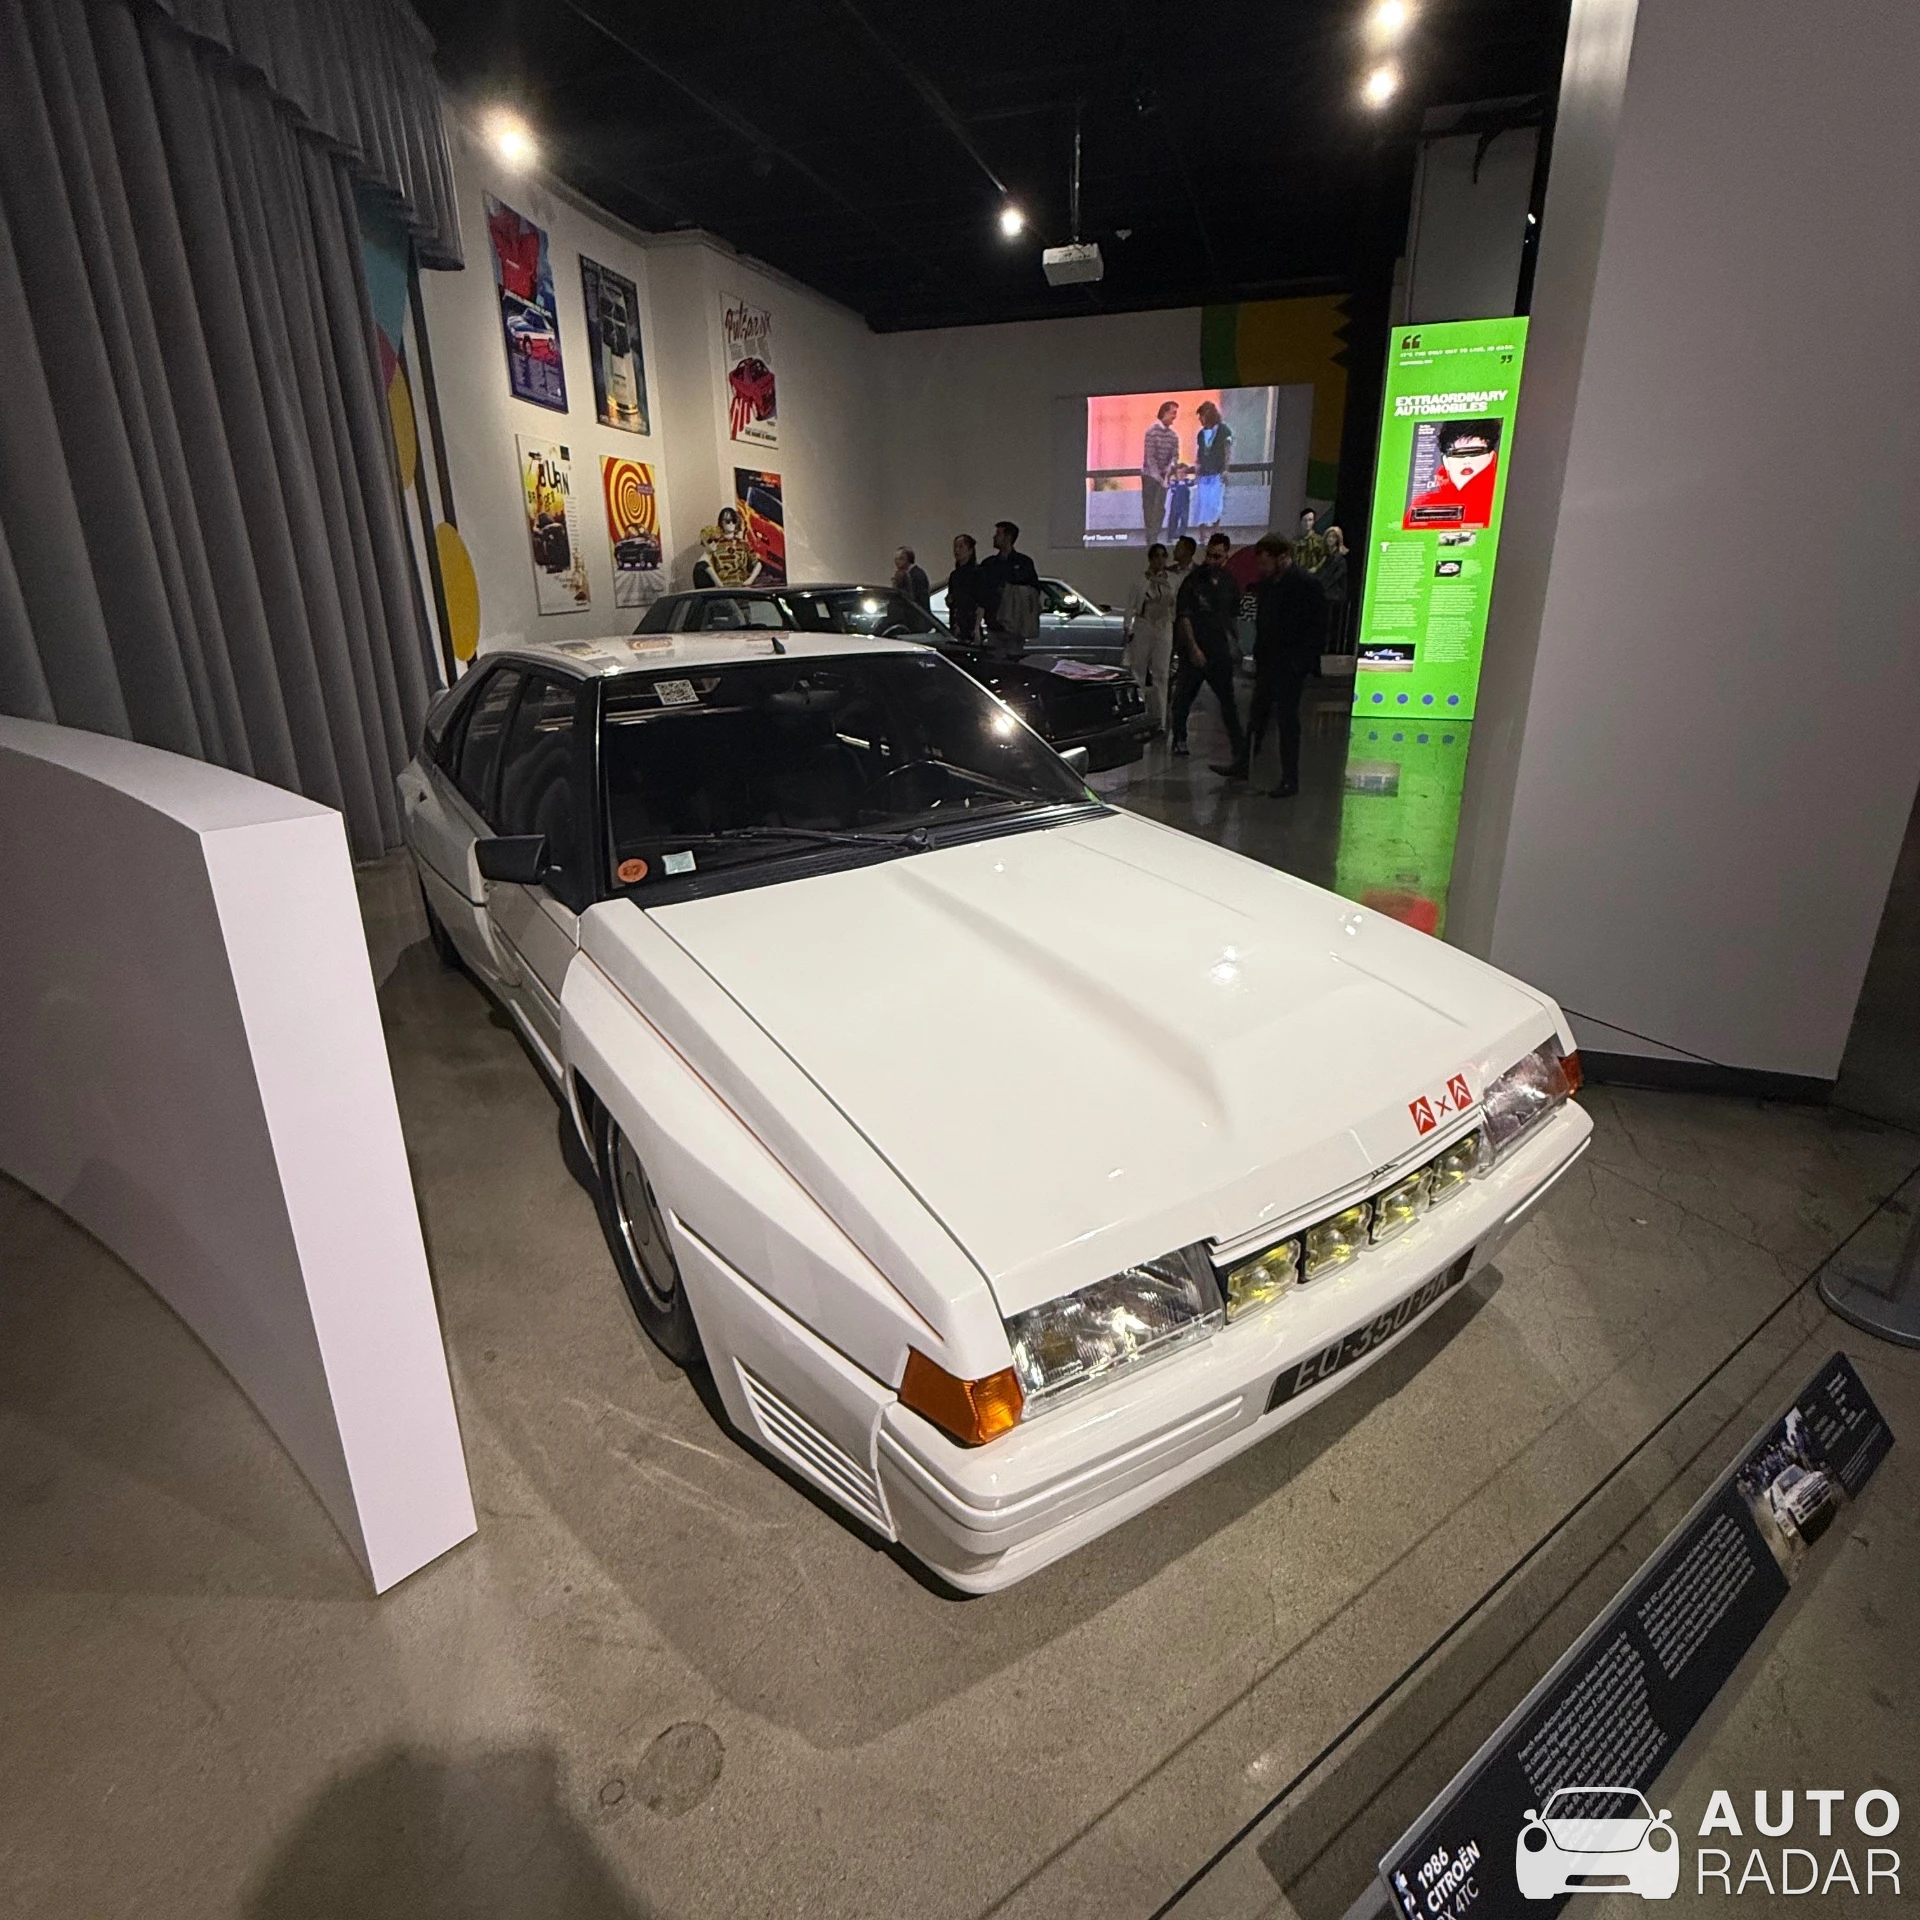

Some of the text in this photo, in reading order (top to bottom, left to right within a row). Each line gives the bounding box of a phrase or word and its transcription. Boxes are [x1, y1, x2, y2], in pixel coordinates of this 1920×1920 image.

[1394, 402, 1488, 417] AUTOMOBILES
[1395, 390, 1508, 406] EXTRAORDINARY
[538, 460, 570, 496] BURN
[1417, 1845, 1449, 1889] 1986
[1427, 1839, 1481, 1913] CITROËN
[1455, 1876, 1479, 1914] 4TC
